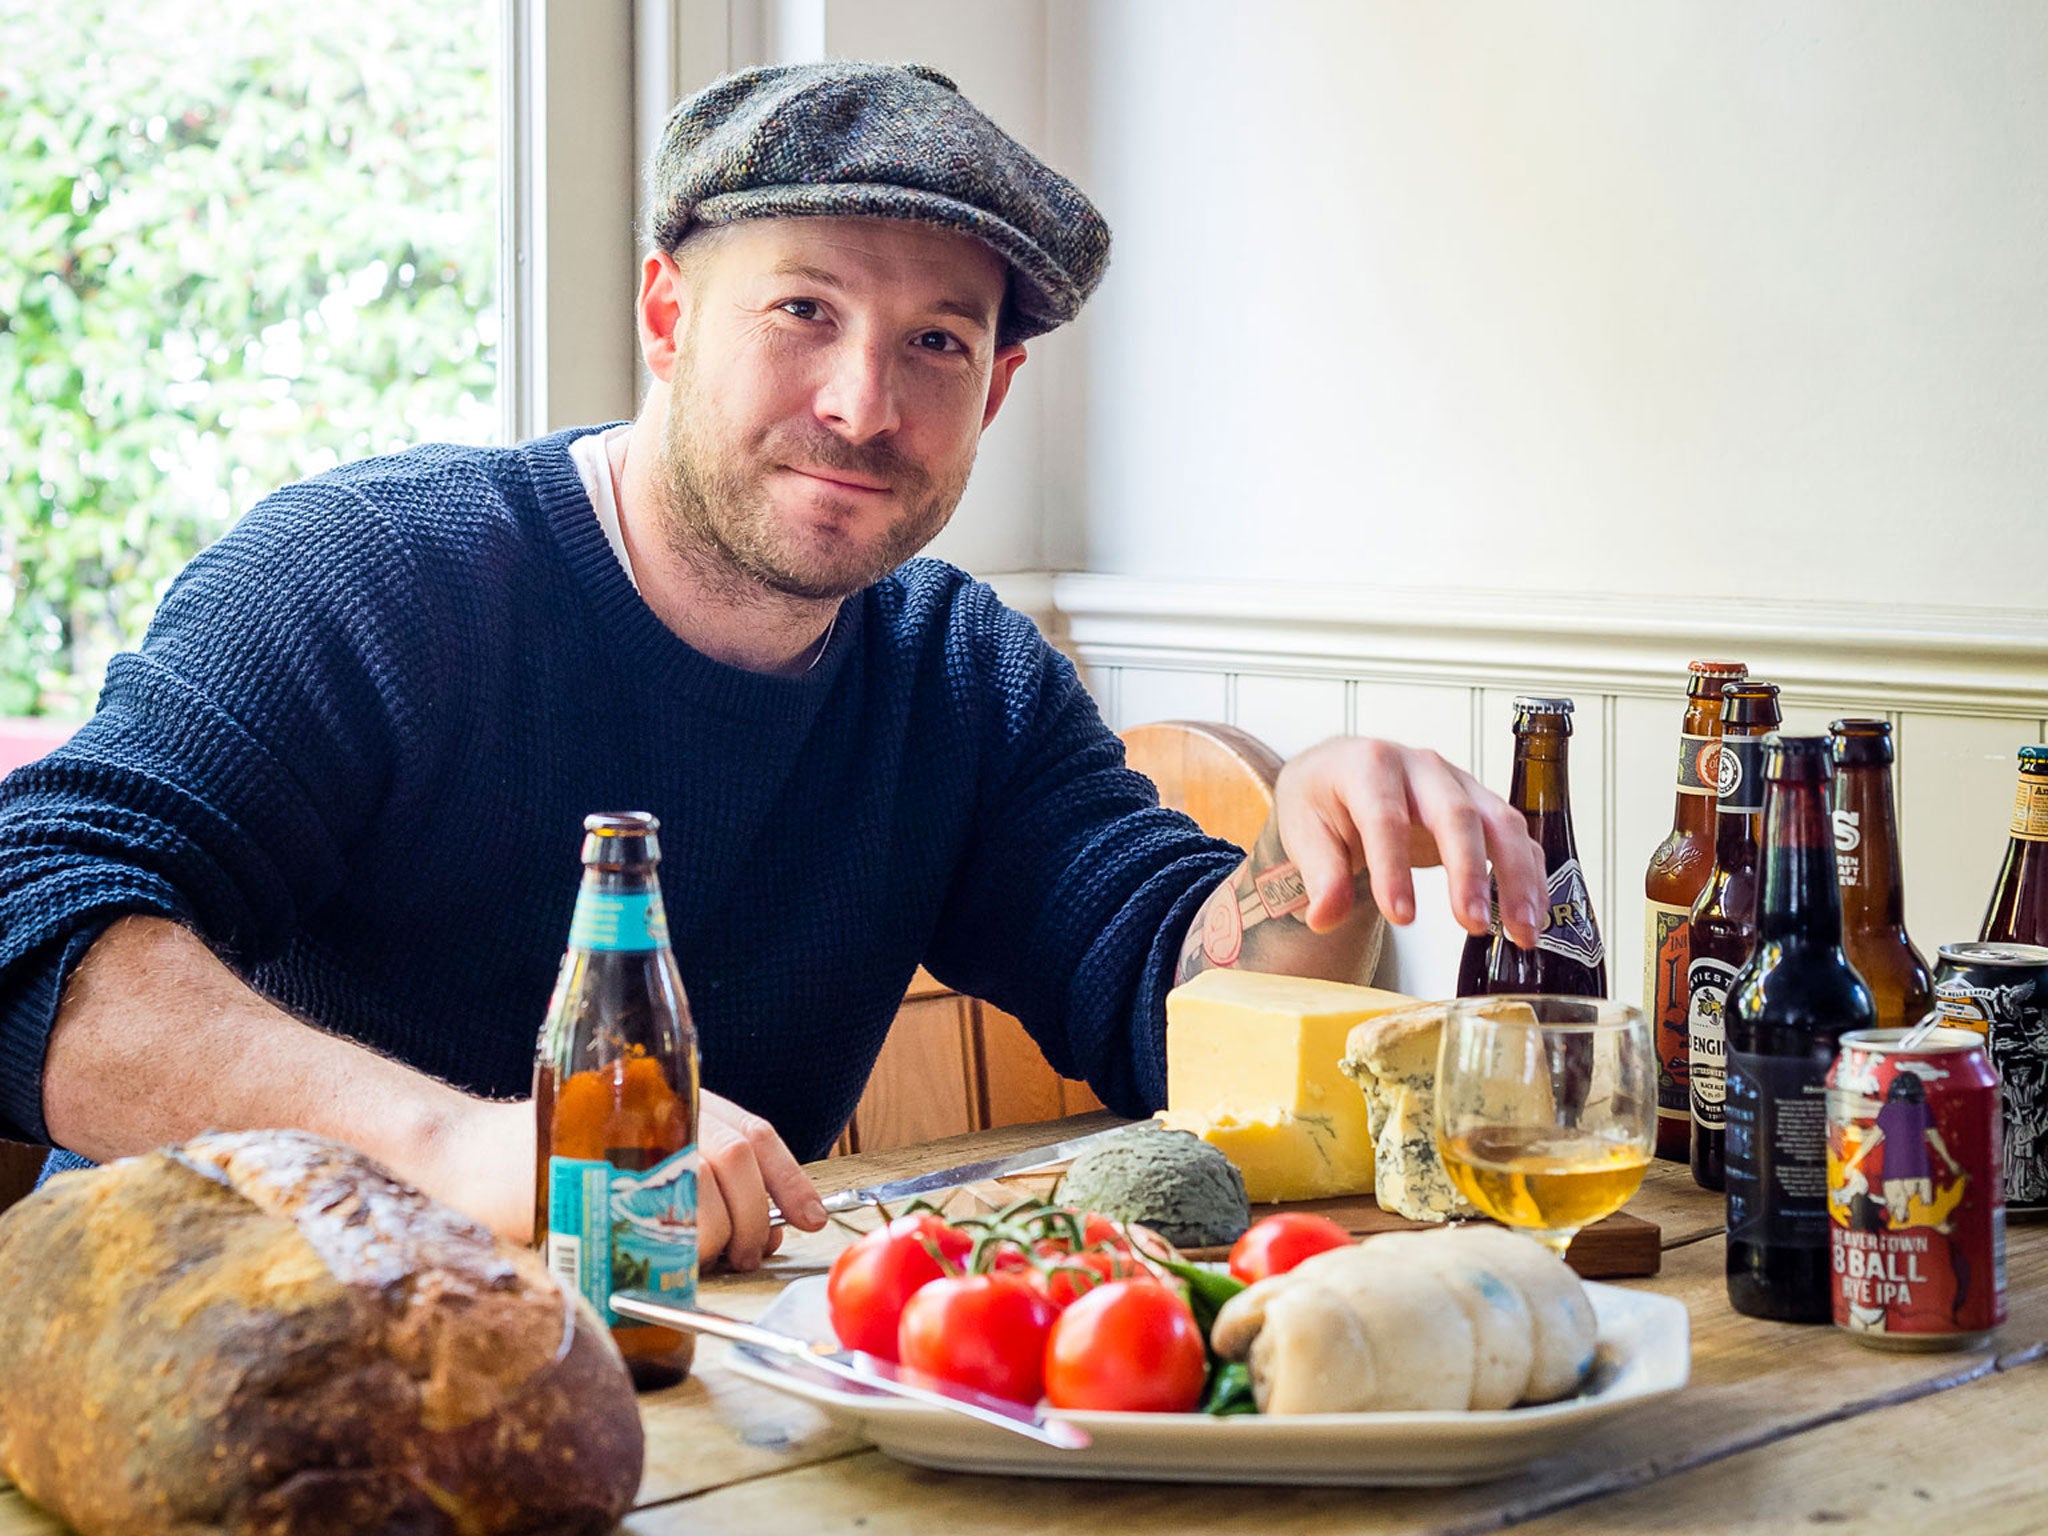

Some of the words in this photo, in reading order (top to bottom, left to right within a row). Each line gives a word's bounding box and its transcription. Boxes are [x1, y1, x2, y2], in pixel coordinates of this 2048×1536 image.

[1833, 1243, 1846, 1274] 8
[1848, 1247, 1928, 1283] BALL
[1842, 1275, 1872, 1303] RYE
[1876, 1281, 1912, 1305] IPA
